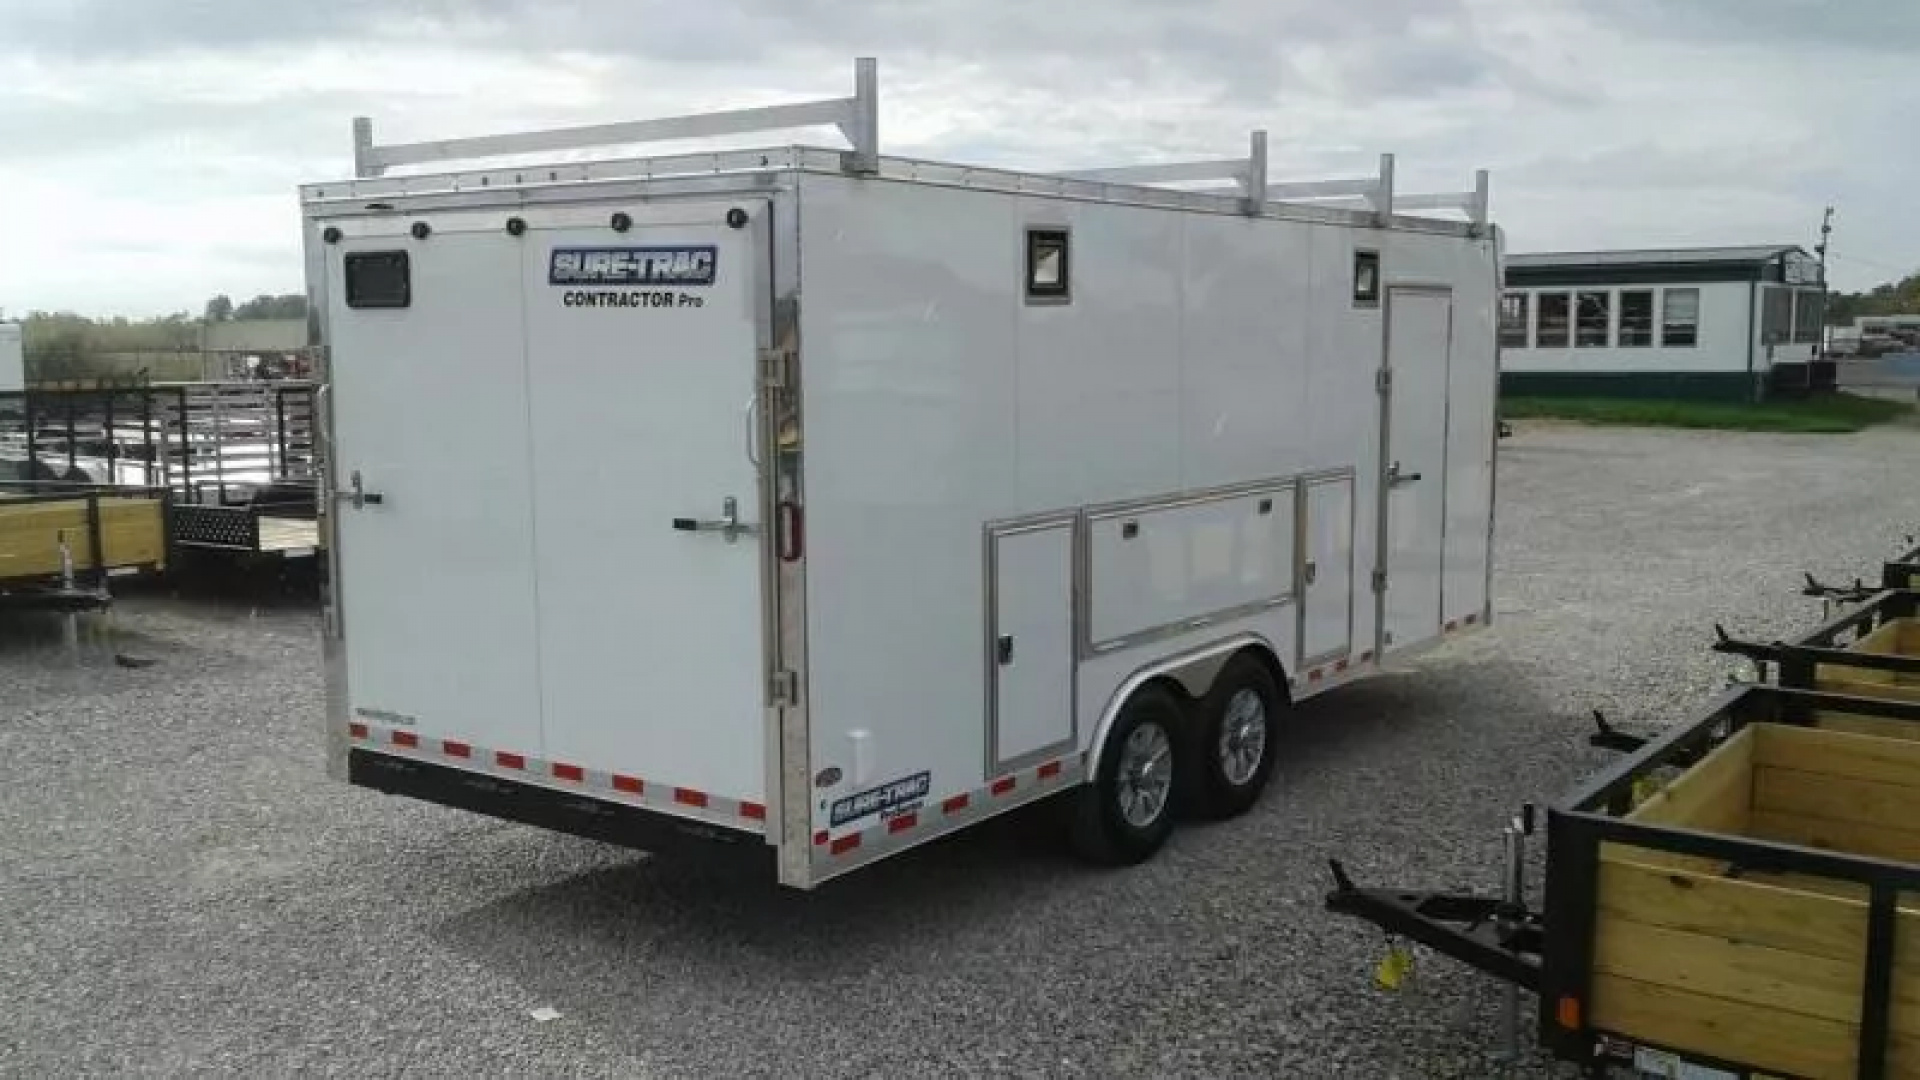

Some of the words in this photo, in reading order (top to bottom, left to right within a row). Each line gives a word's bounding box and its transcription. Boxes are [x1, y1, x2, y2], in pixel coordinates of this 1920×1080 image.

[553, 249, 713, 281] SURE-TRAC
[563, 291, 674, 308] CONTRACTOR
[678, 293, 704, 308] Pro
